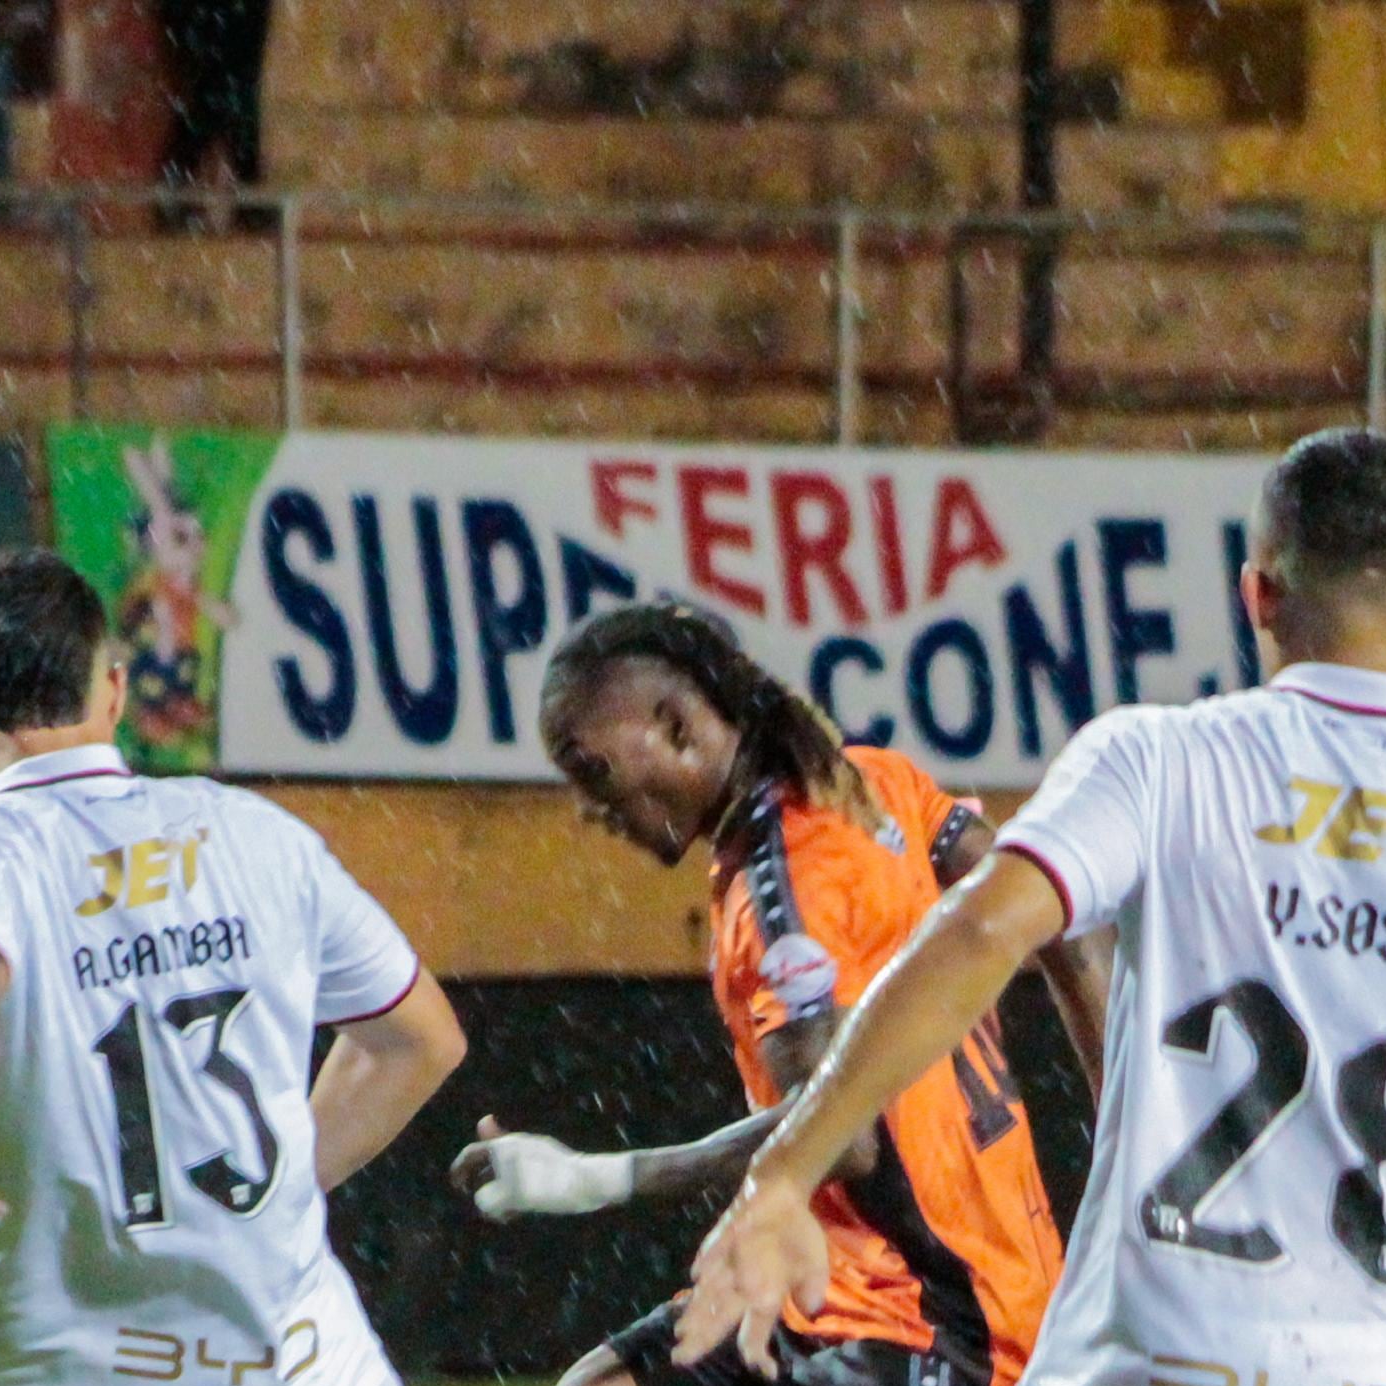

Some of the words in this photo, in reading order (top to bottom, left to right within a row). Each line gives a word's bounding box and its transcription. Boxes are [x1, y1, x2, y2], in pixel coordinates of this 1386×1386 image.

[261, 487, 637, 746] SUP
[809, 517, 1261, 760] CONEJ
[589, 456, 1007, 628] FERIA
[74, 827, 210, 919] JET
[92, 987, 285, 1233] 13
